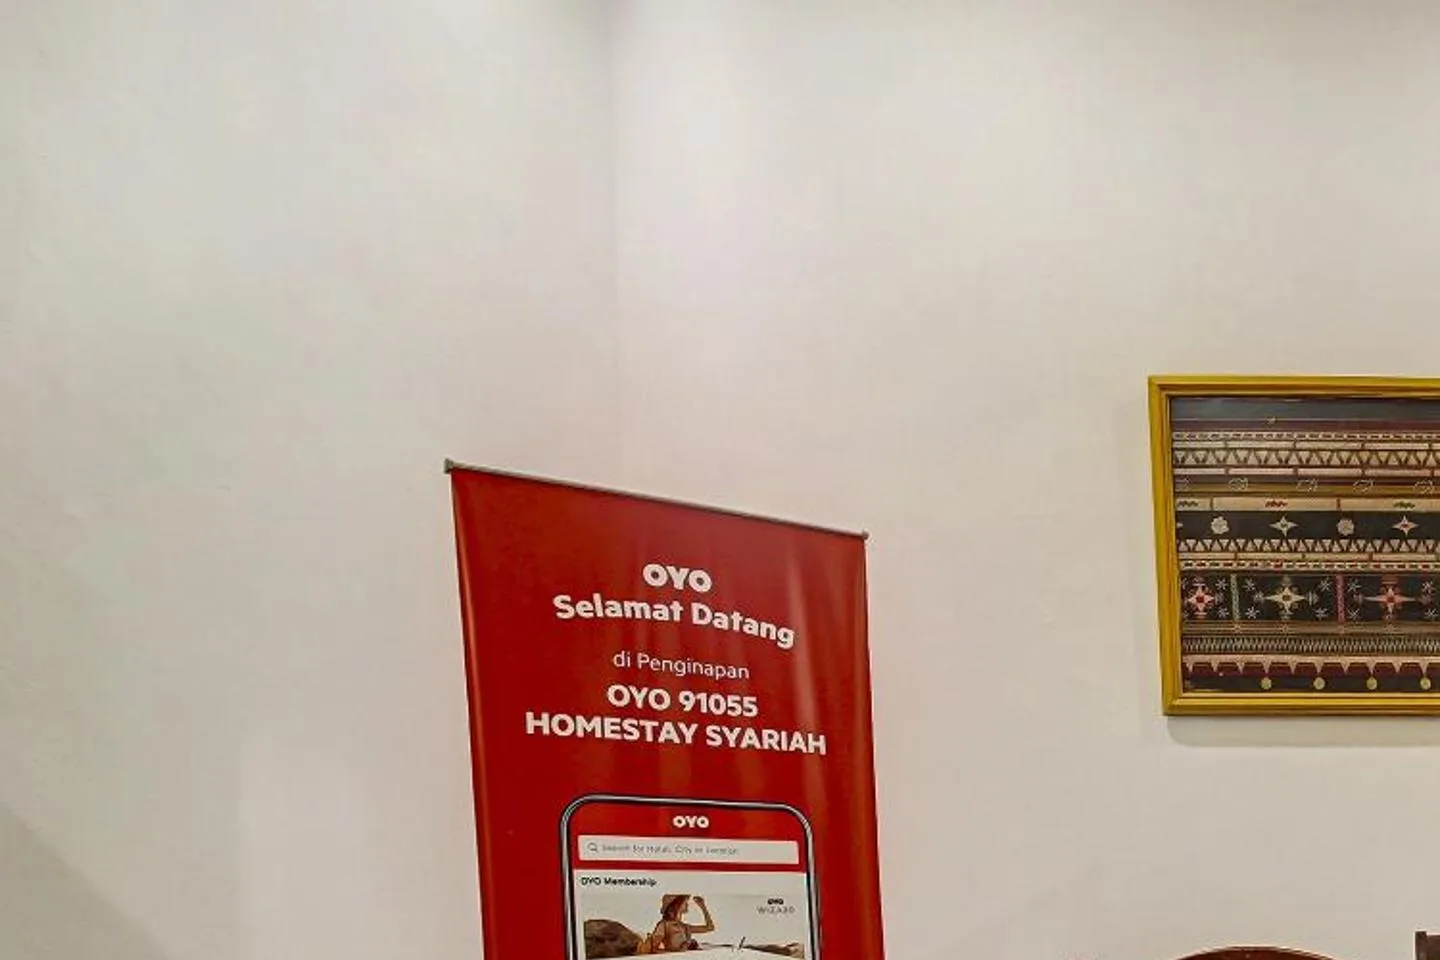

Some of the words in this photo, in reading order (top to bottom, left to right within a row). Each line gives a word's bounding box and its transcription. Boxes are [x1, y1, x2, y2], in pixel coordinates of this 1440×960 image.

[642, 563, 712, 593] OYO
[552, 593, 683, 623] Selamat
[691, 602, 796, 650] Datang
[612, 651, 631, 668] di
[636, 652, 750, 680] Penginapan
[606, 684, 671, 711] OYO
[678, 691, 759, 718] 91055
[524, 711, 698, 745] HOMESTAY
[705, 724, 828, 756] SYARIAH
[672, 815, 710, 829] OYO
[603, 877, 657, 888] Membership
